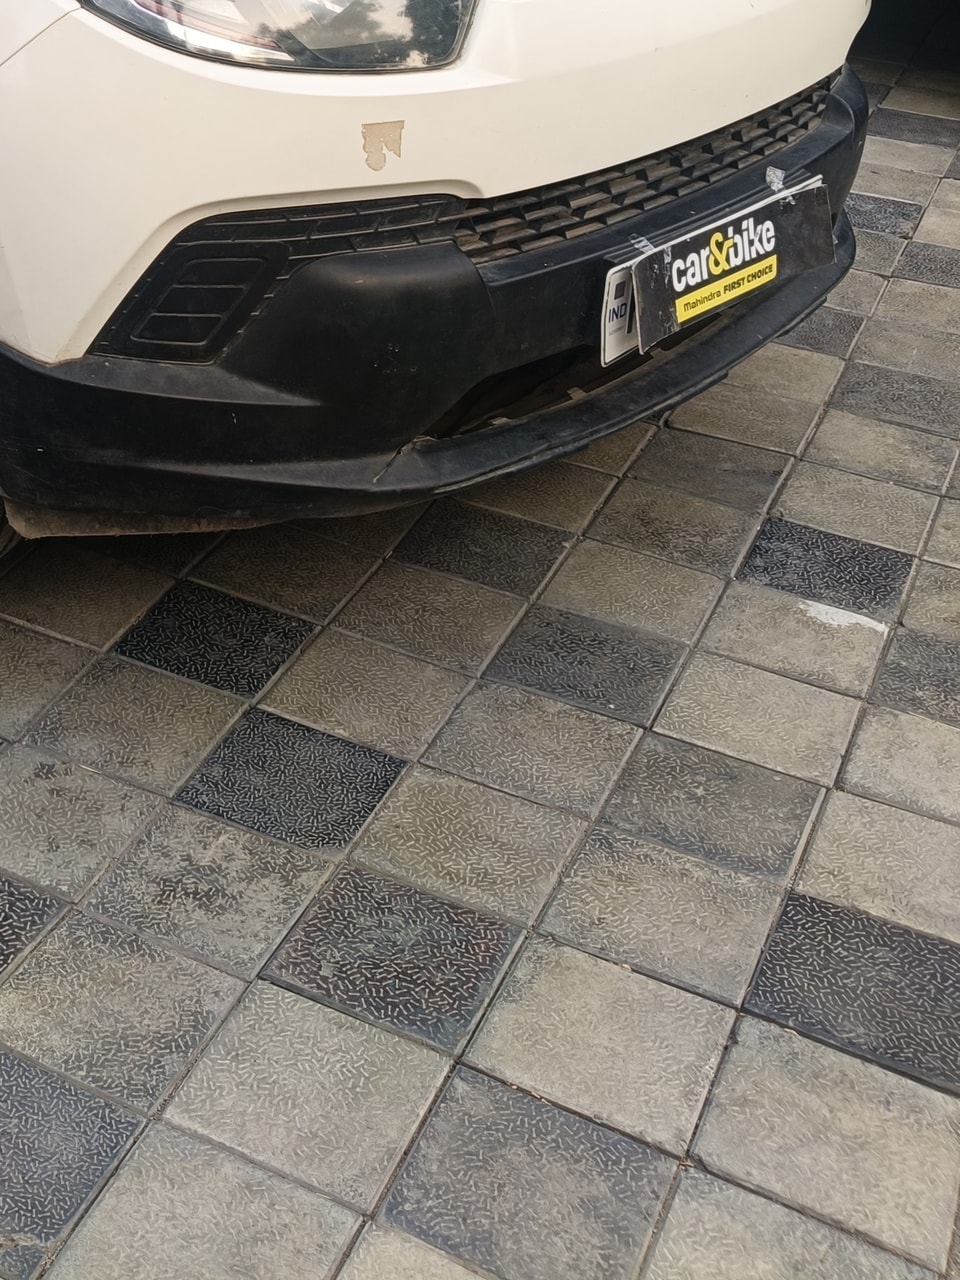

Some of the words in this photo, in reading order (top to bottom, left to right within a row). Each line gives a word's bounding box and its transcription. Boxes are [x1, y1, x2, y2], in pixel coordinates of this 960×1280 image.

[672, 217, 776, 293] car&bike
[683, 290, 722, 312] Mahindra
[723, 277, 745, 295] FIRST
[746, 263, 774, 284] CHOICE
[608, 302, 627, 323] IND
